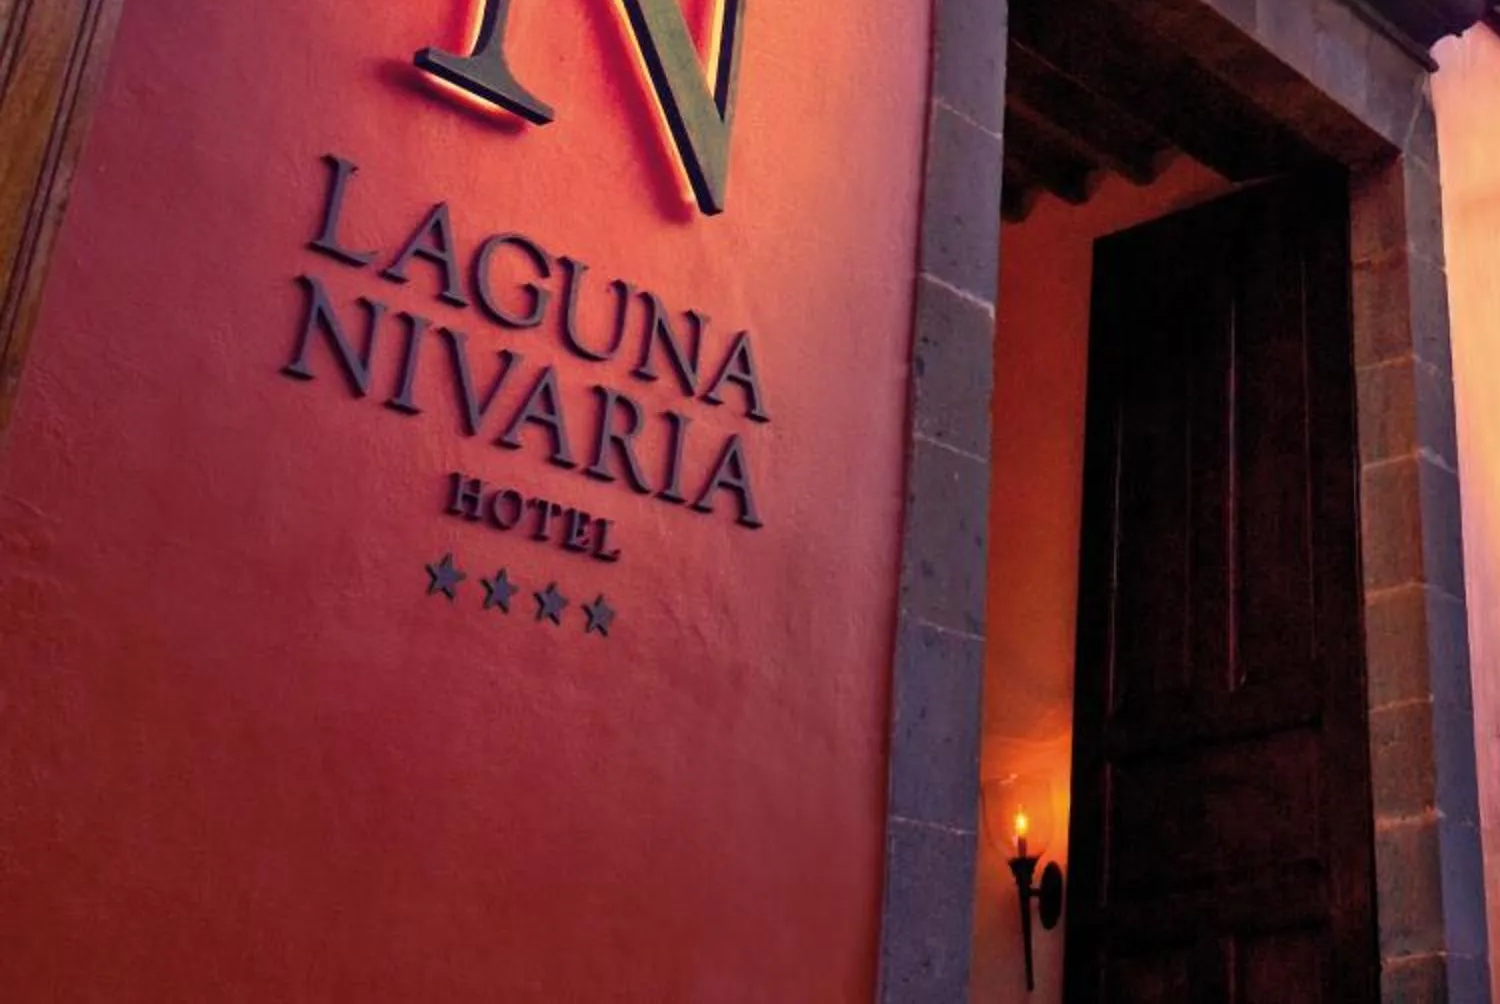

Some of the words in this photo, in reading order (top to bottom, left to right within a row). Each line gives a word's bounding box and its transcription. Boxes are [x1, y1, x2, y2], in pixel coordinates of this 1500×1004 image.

[280, 274, 764, 529] NIVARIA
[307, 153, 771, 423] LAGUNA
[443, 471, 621, 562] HOTEL
